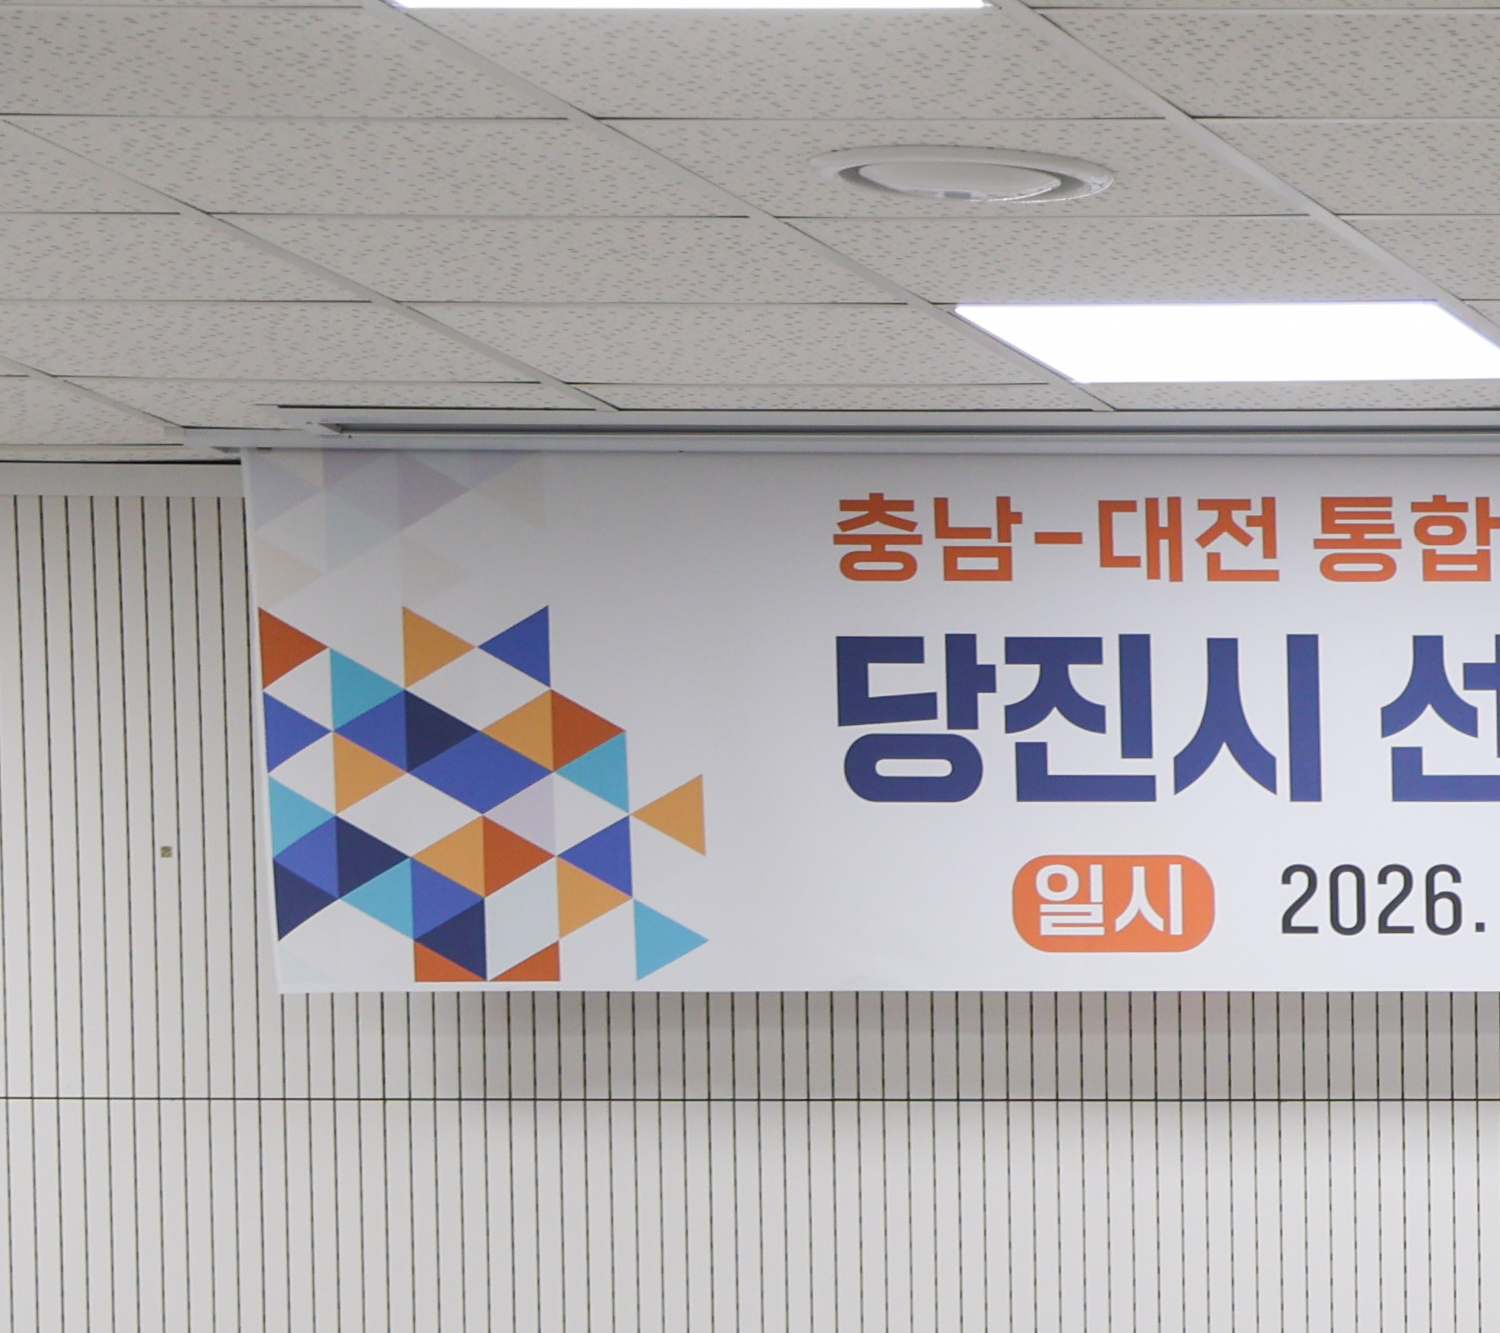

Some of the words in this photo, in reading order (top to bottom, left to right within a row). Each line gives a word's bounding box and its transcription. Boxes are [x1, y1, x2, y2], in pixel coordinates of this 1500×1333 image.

[835, 494, 1280, 583] 충남-대전
[837, 633, 1322, 804] 당진시
[1034, 864, 1186, 938] 일시
[1281, 864, 1486, 936] 2026.
